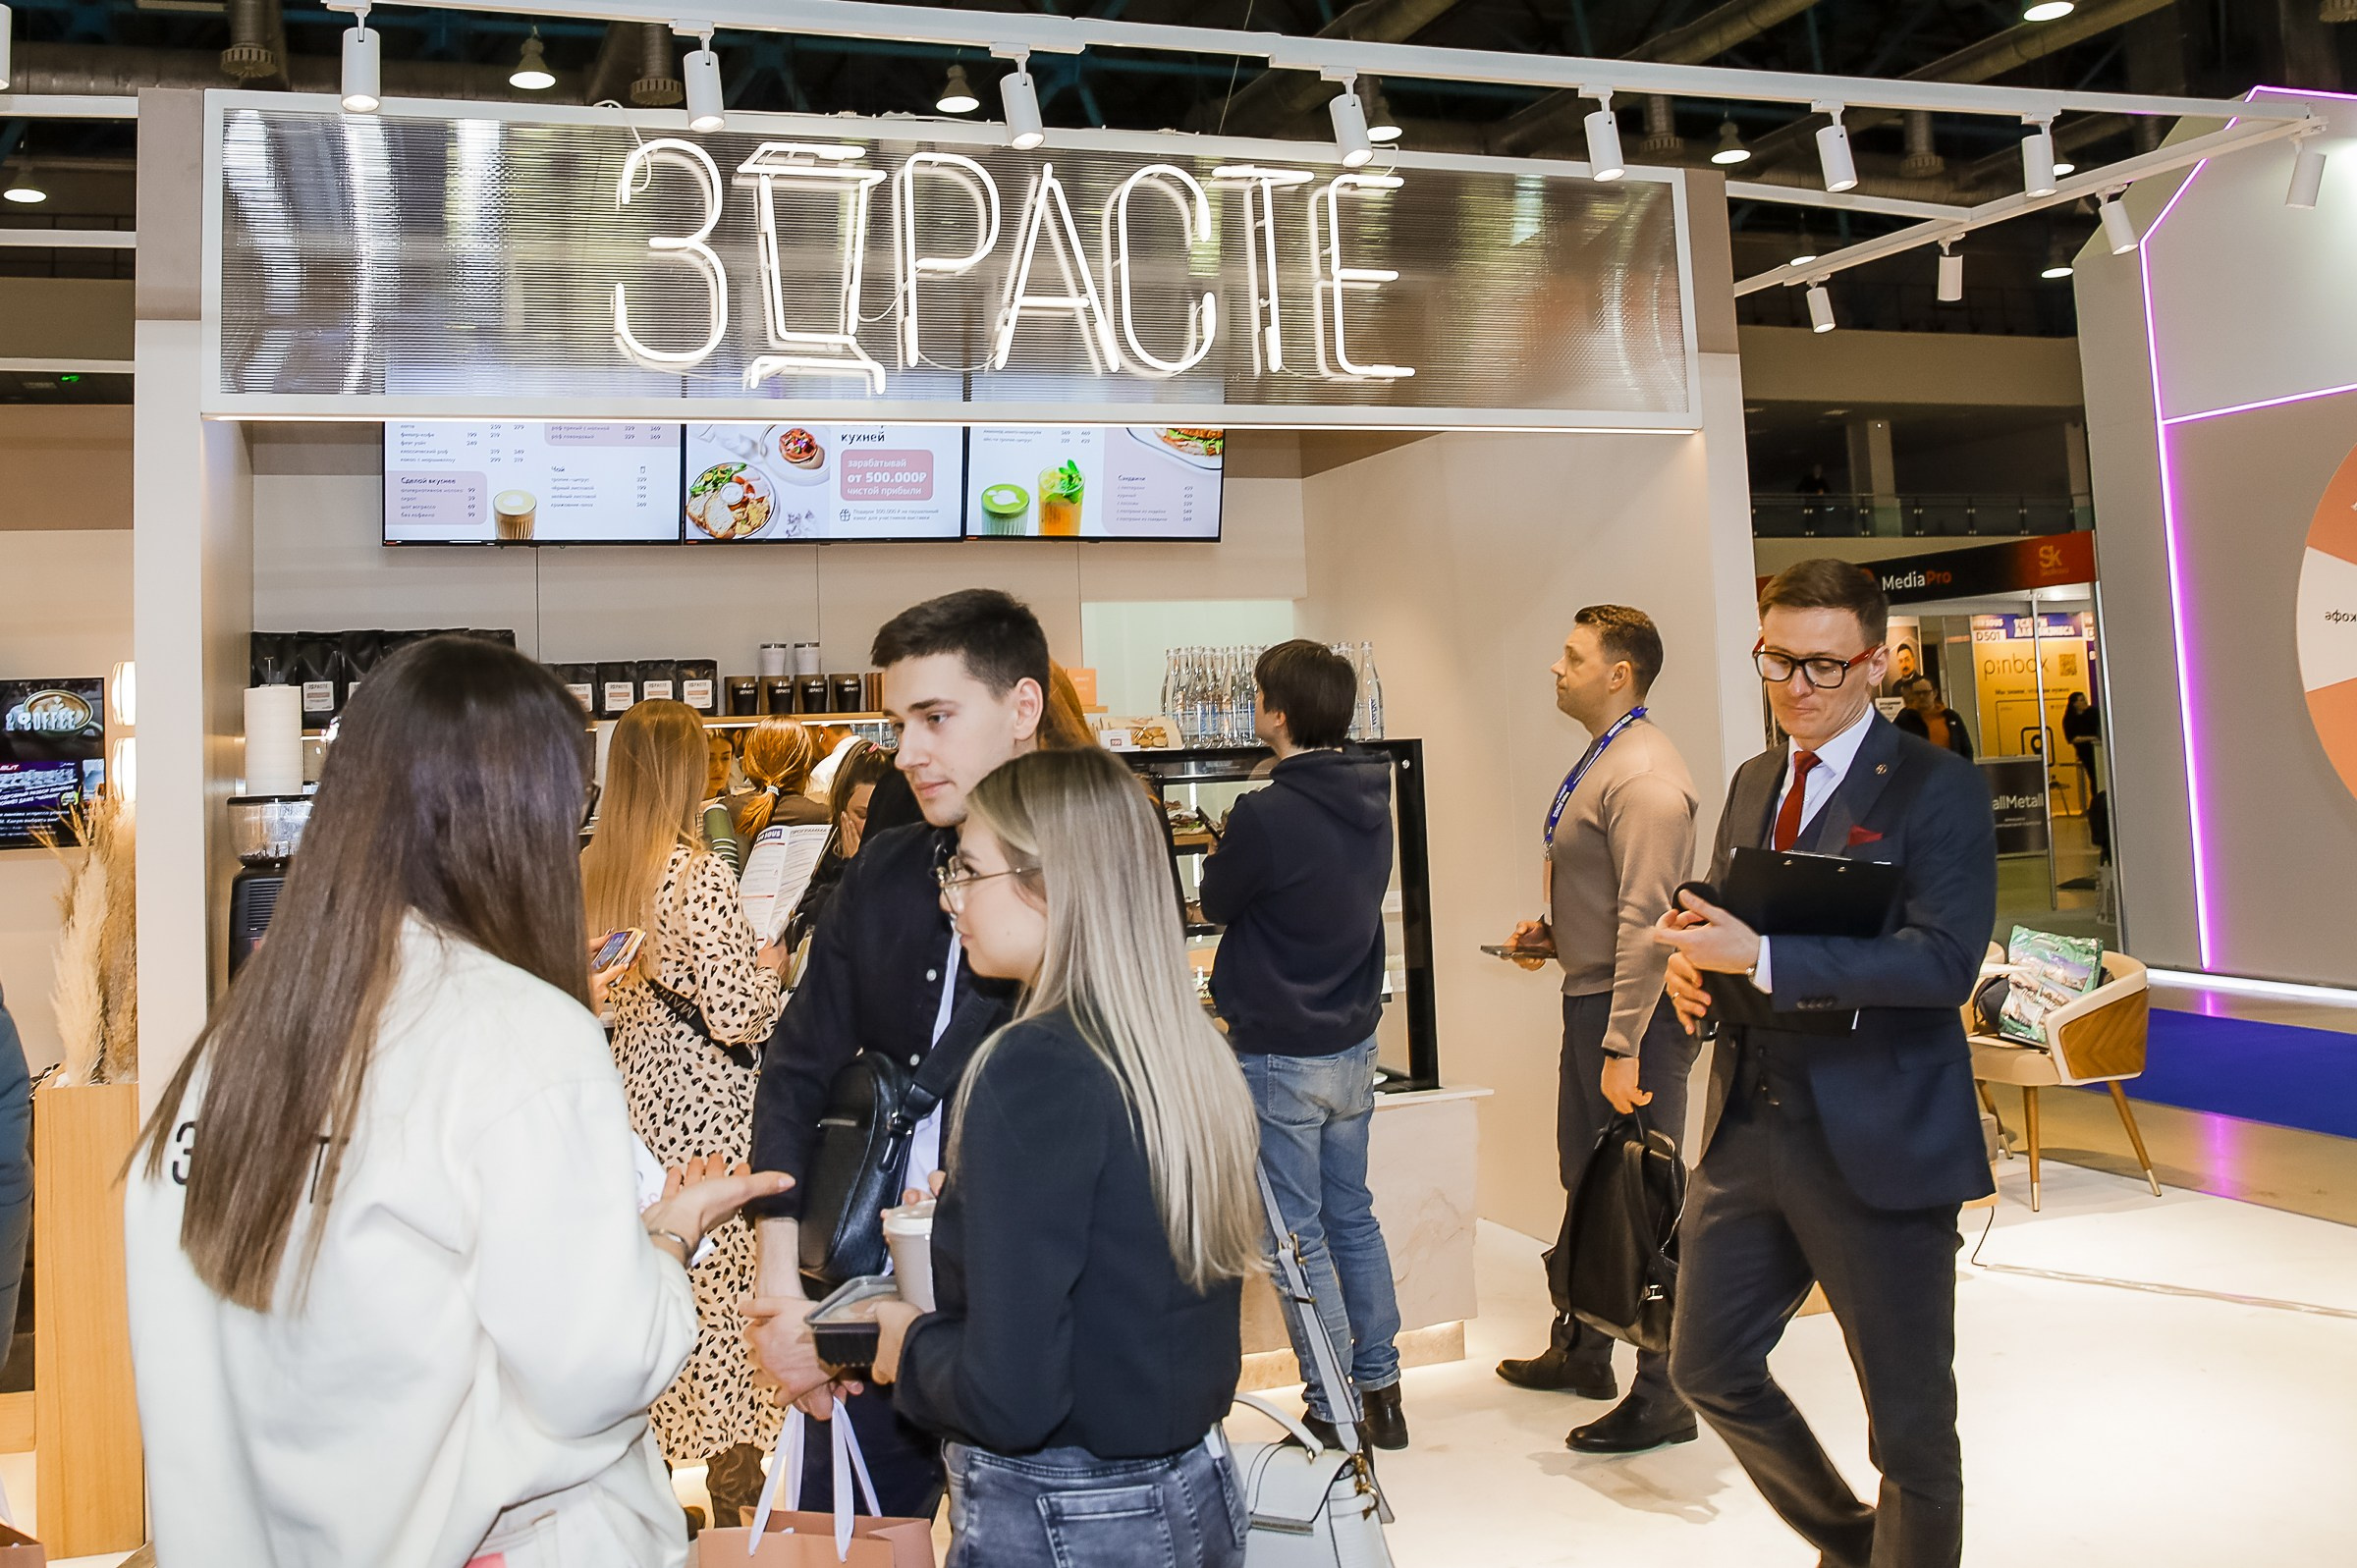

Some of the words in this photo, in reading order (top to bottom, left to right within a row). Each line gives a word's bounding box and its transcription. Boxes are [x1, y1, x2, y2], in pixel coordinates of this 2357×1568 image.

[613, 137, 1415, 395] ЗДРАСТЕ
[841, 431, 885, 445] кухней
[849, 459, 906, 468] зарабатывай
[848, 474, 861, 483] от
[848, 486, 879, 495] чистой
[881, 486, 921, 497] прибыли
[1882, 569, 1951, 591] MediaPro
[1976, 631, 2001, 641] D501
[1984, 653, 2050, 681] pinbox
